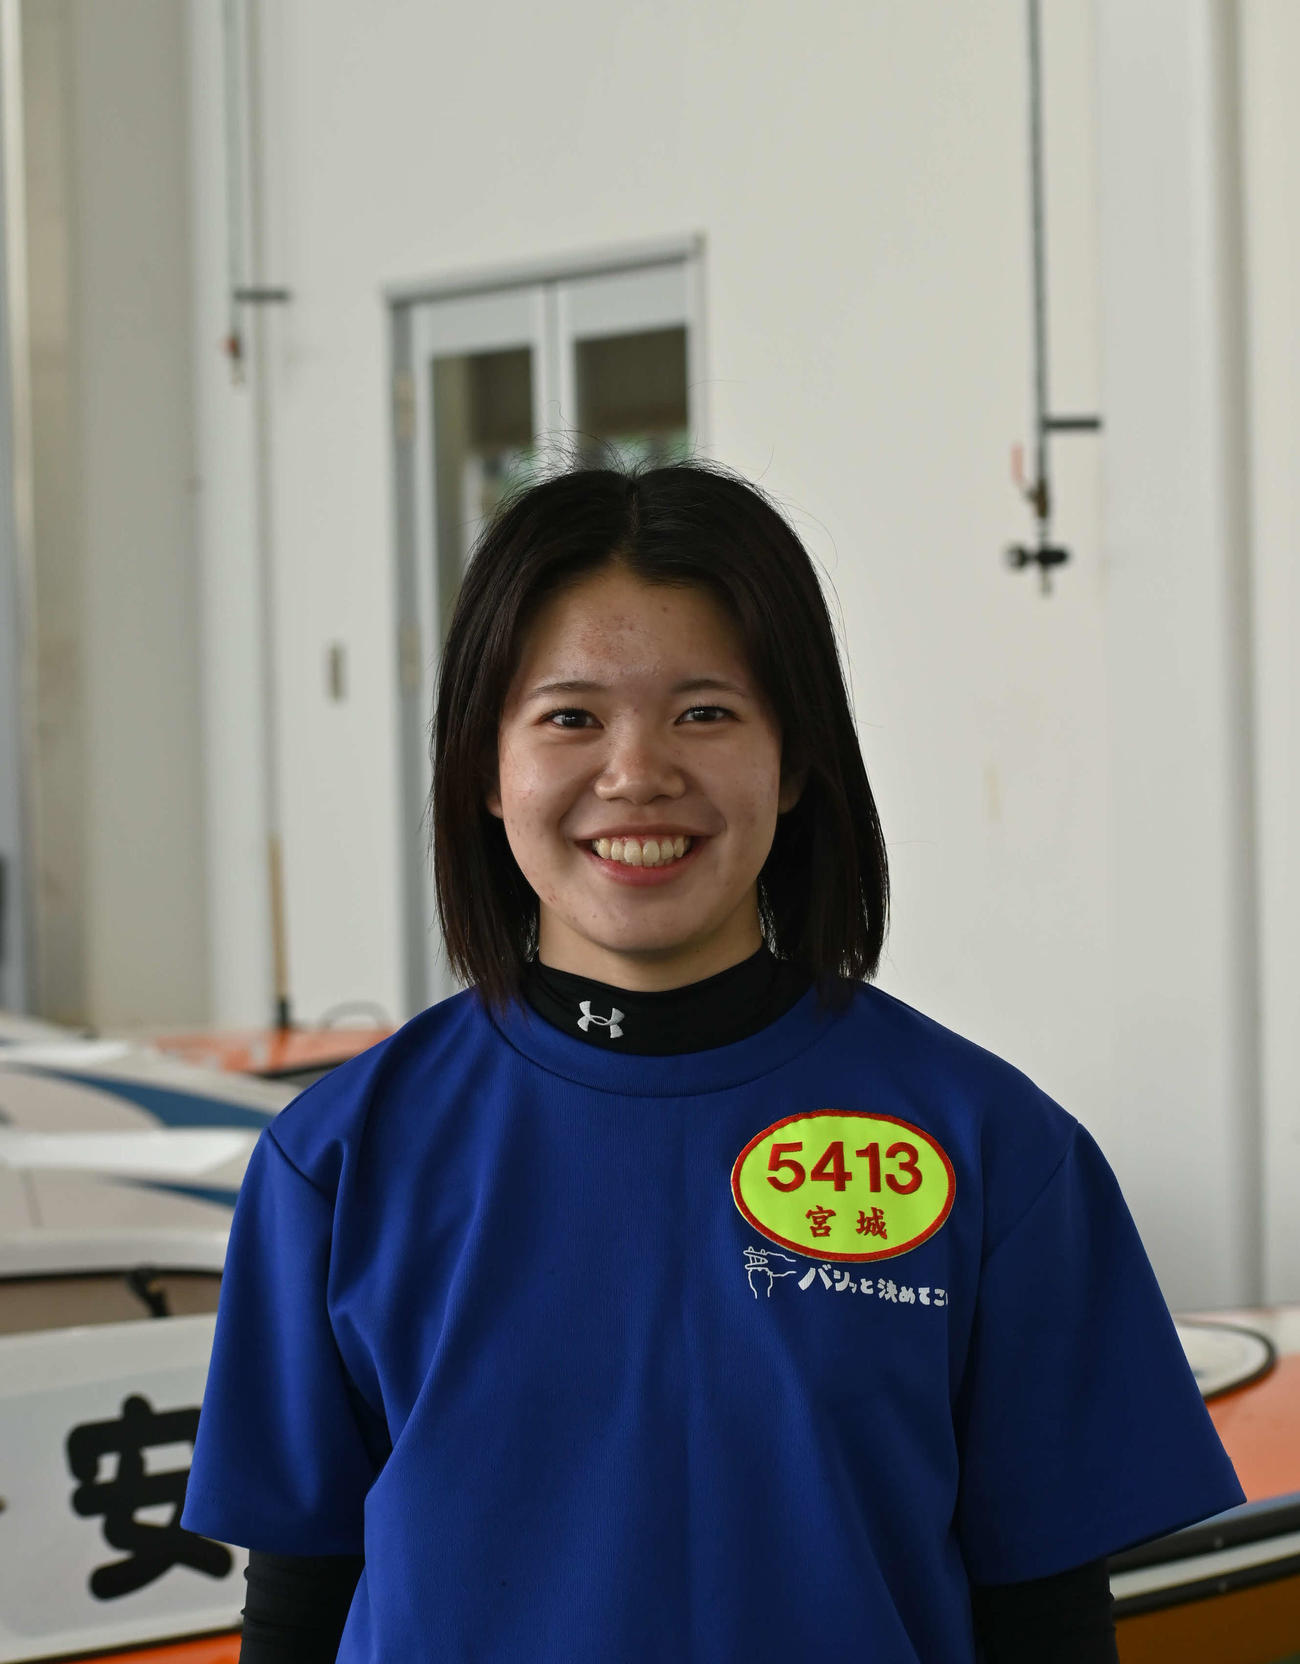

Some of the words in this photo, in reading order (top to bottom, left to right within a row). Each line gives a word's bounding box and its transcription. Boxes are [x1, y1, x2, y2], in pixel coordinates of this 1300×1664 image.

[766, 1141, 923, 1195] 5413
[805, 1205, 888, 1240] 宮城
[66, 1394, 232, 1600] 安
